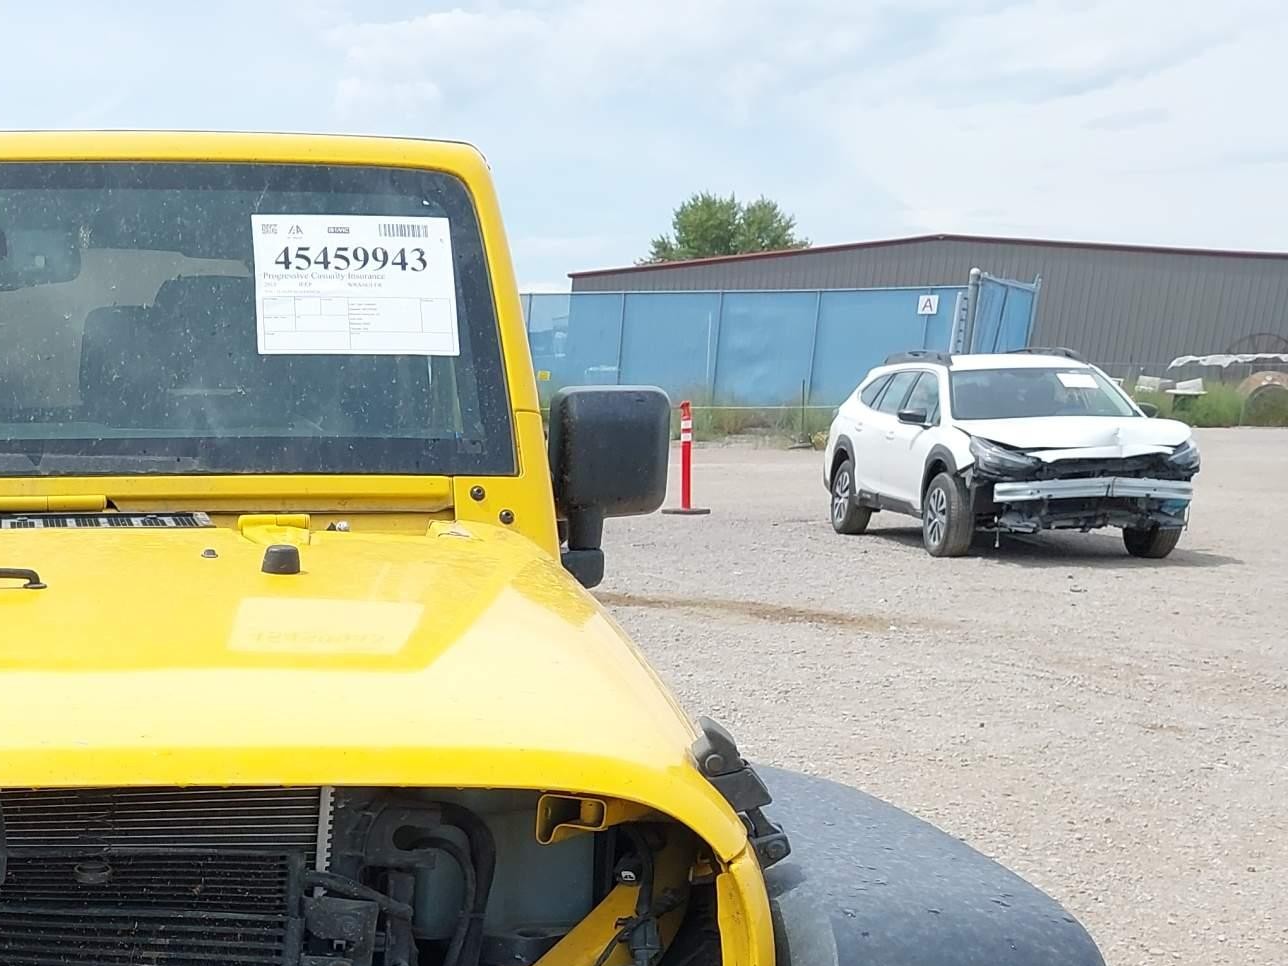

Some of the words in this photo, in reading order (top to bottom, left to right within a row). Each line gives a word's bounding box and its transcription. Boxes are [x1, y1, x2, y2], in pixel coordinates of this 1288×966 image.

[275, 246, 428, 272] 45459943
[263, 271, 310, 281] Progressive
[347, 271, 386, 280] Insurance
[922, 298, 933, 312] A
